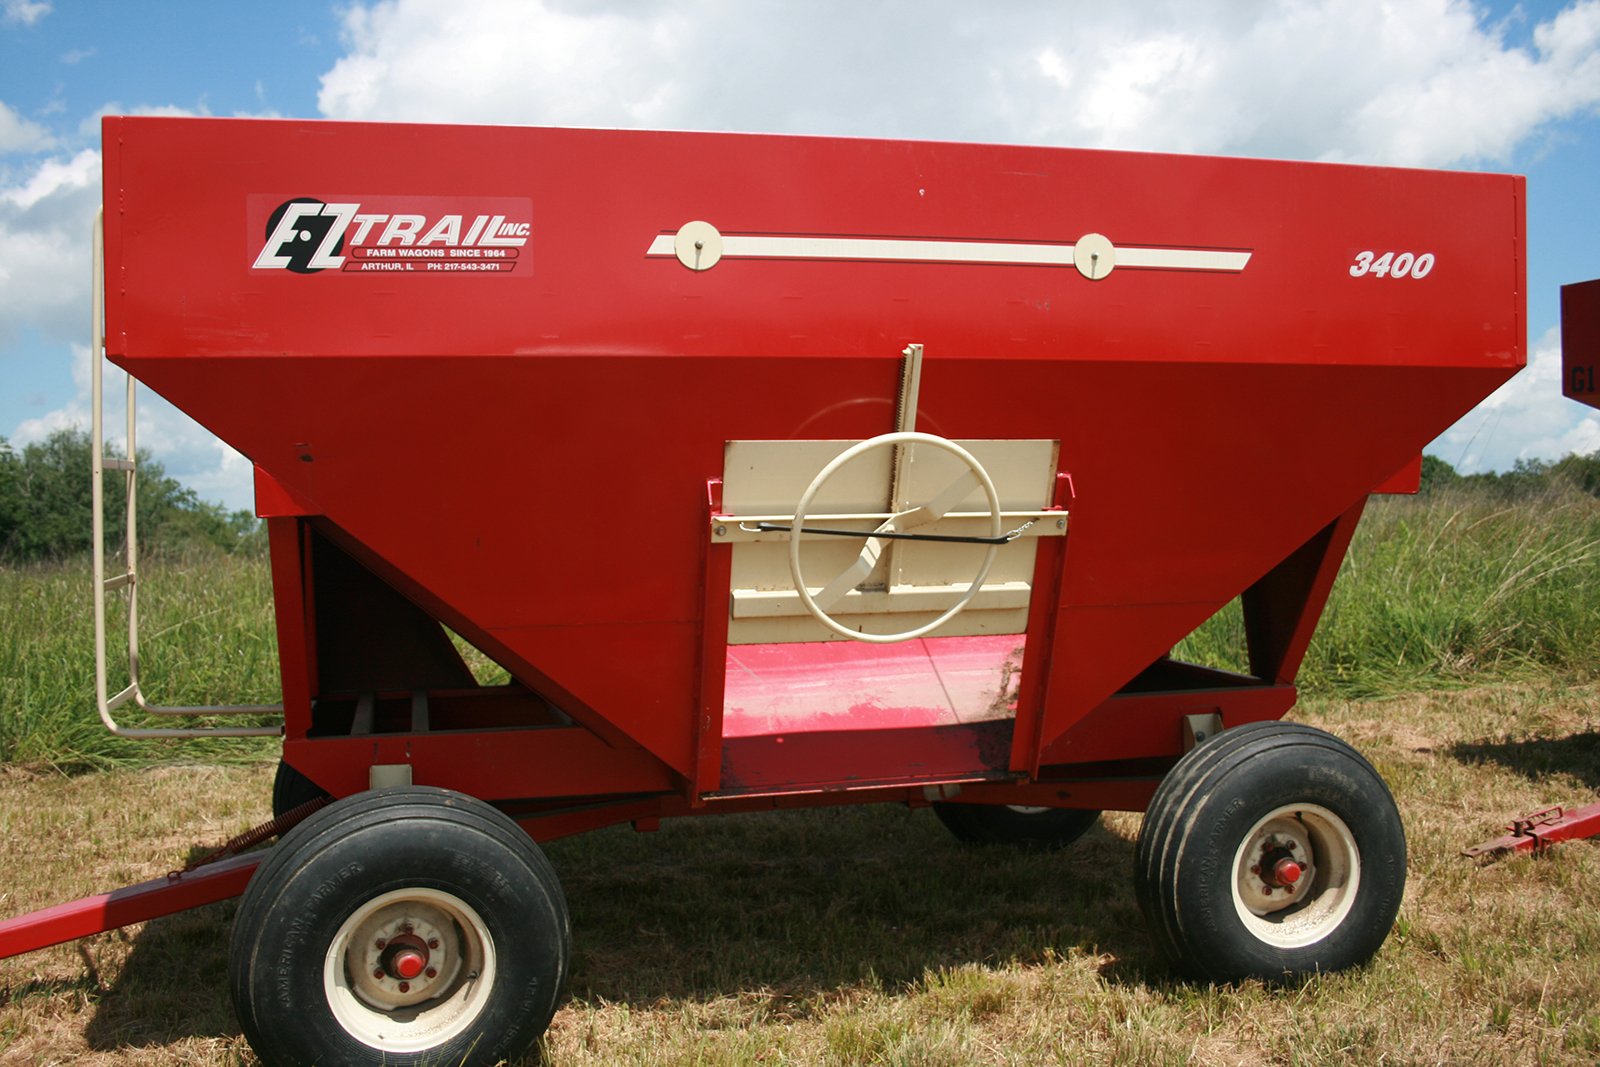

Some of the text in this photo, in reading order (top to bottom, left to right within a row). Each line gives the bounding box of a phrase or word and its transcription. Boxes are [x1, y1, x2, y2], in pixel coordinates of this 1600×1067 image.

[350, 215, 528, 247] TRAIL
[497, 223, 531, 237] INC.
[361, 262, 500, 272] ARTHUR, IL PH: 217-543-3471
[366, 249, 506, 258] FARM WAGONS SINCE 1964
[1349, 250, 1435, 279] 3400
[1199, 855, 1218, 933] AMERICAN
[277, 916, 305, 1009] AMERICAN
[302, 860, 365, 911] FARMER
